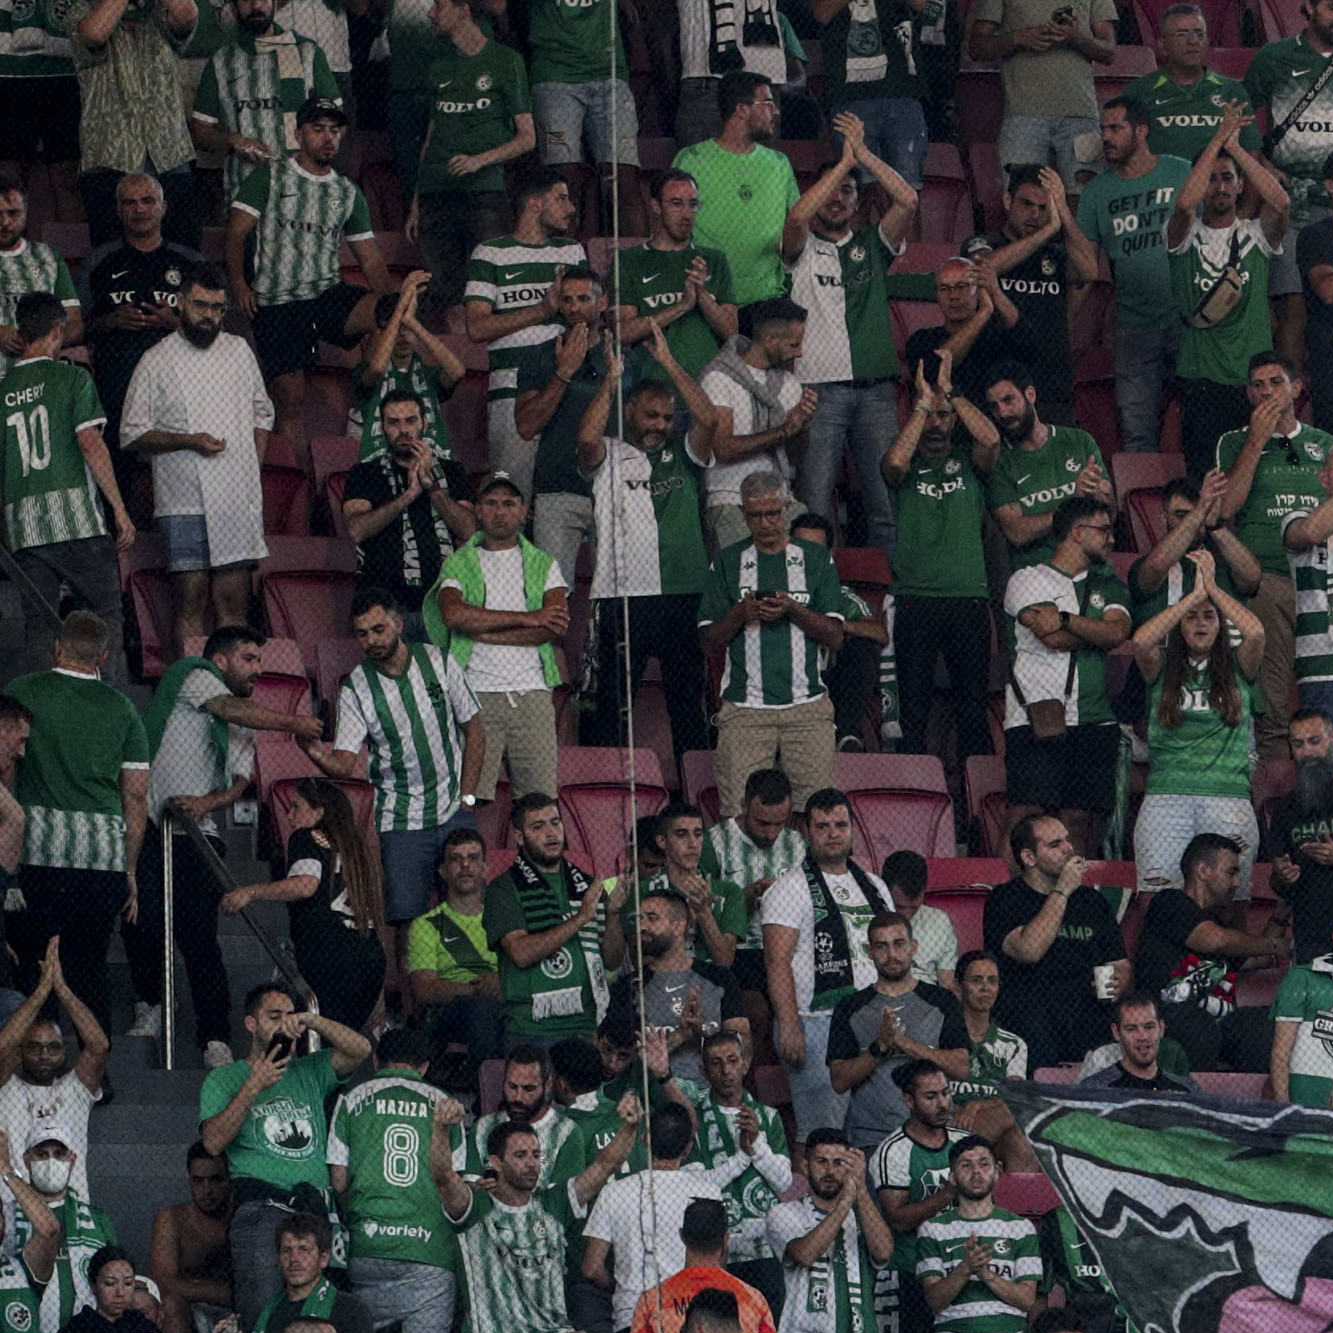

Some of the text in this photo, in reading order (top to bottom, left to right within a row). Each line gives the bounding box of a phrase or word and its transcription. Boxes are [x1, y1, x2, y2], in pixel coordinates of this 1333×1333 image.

[437, 98, 490, 113] VOLVO
[1108, 187, 1174, 214] GET FIT
[1000, 278, 1060, 295] VOLVO
[111, 290, 177, 307] VOVO
[5, 387, 45, 407] CHERY
[8, 403, 52, 477] 10
[375, 1097, 429, 1118] HAZIZA
[383, 1123, 419, 1187] 8
[377, 1223, 432, 1243] variety
